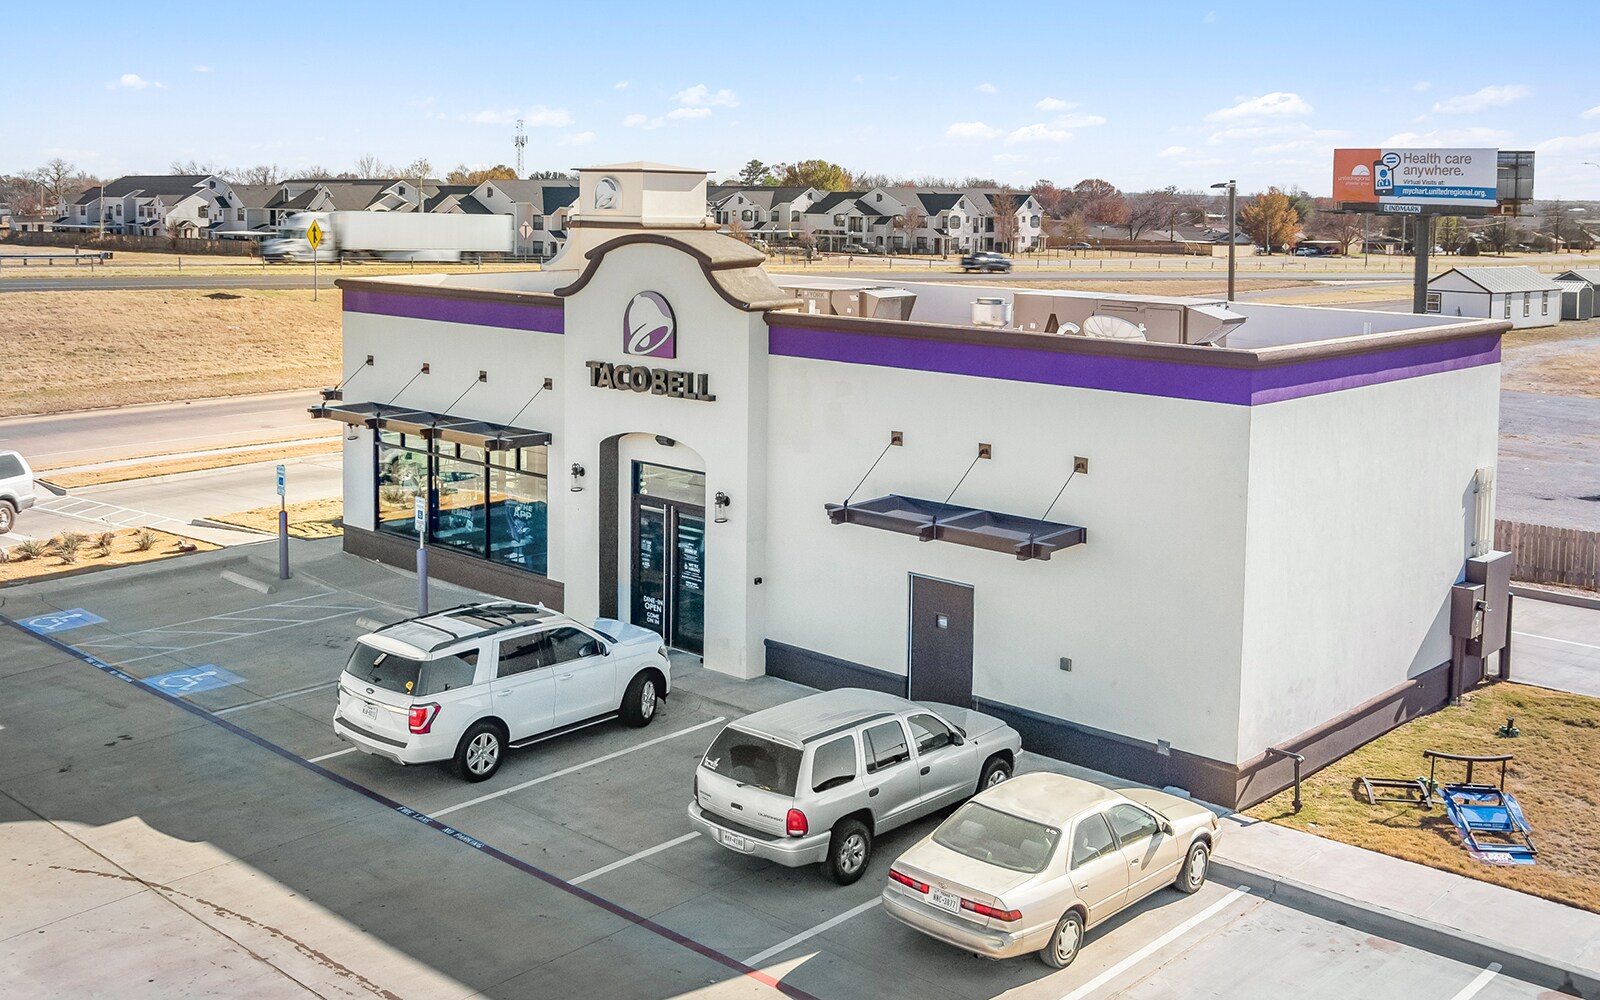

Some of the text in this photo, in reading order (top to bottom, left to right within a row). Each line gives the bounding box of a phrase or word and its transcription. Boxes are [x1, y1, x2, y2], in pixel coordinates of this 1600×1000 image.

[1403, 152, 1472, 164] Health care
[1403, 165, 1464, 178] anywhere.
[1384, 204, 1420, 212] LINDMARK
[519, 504, 533, 512] THE
[513, 509, 532, 519] APP
[644, 602, 662, 613] OPEN
[646, 611, 660, 619] COME
